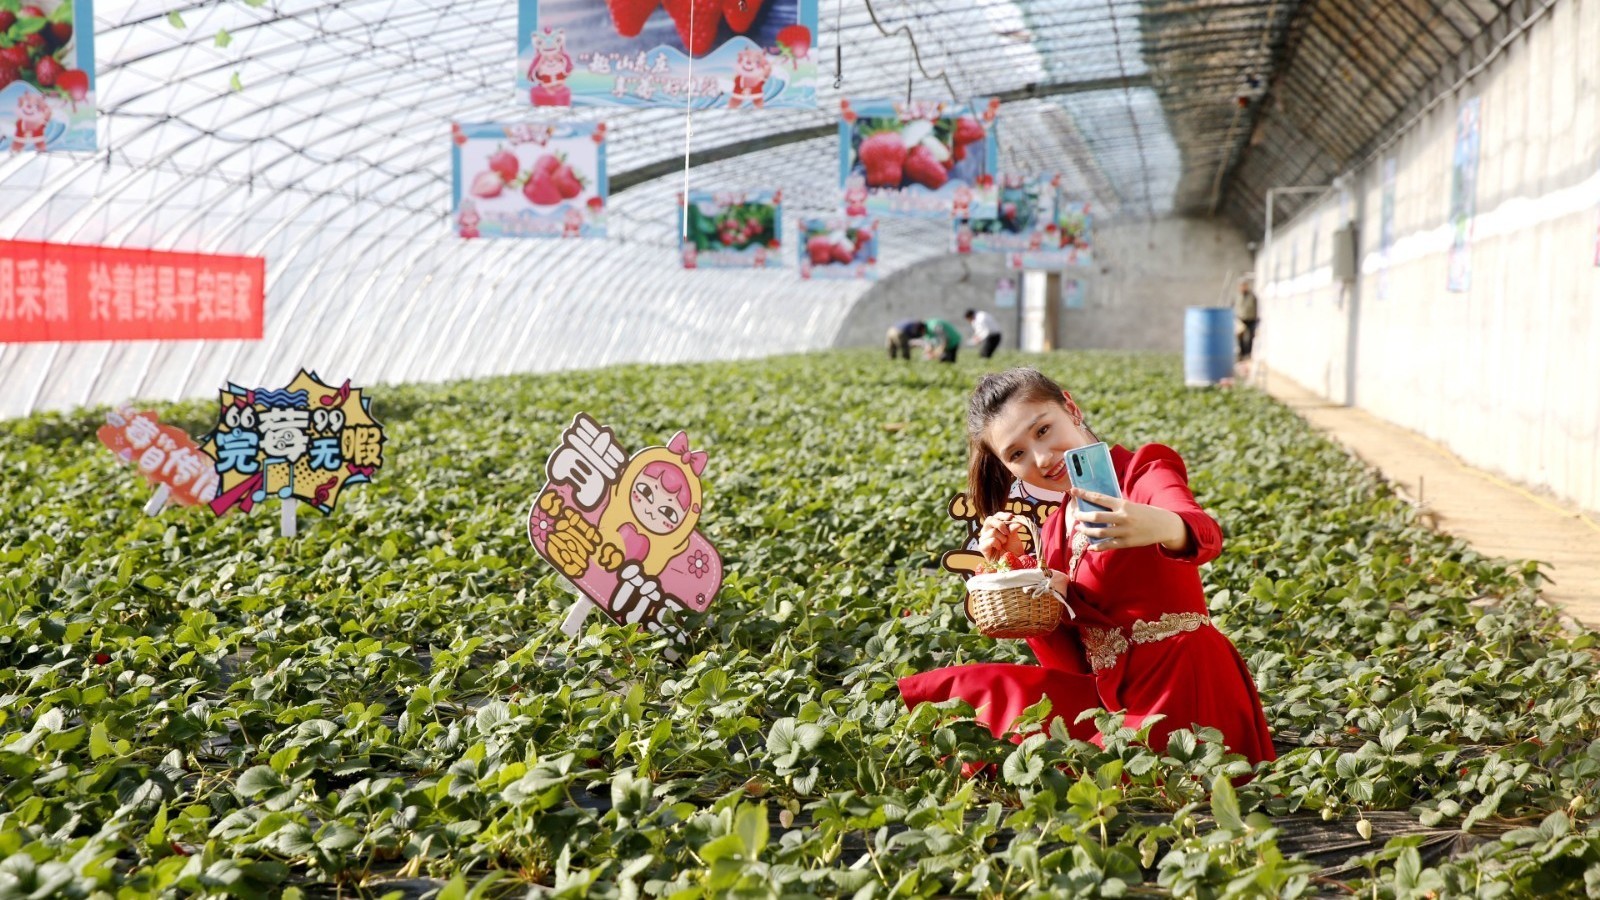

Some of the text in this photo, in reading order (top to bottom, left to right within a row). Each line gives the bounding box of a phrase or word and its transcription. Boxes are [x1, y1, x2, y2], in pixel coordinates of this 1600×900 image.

[88, 261, 252, 322] 拎着鲜果平安回家
